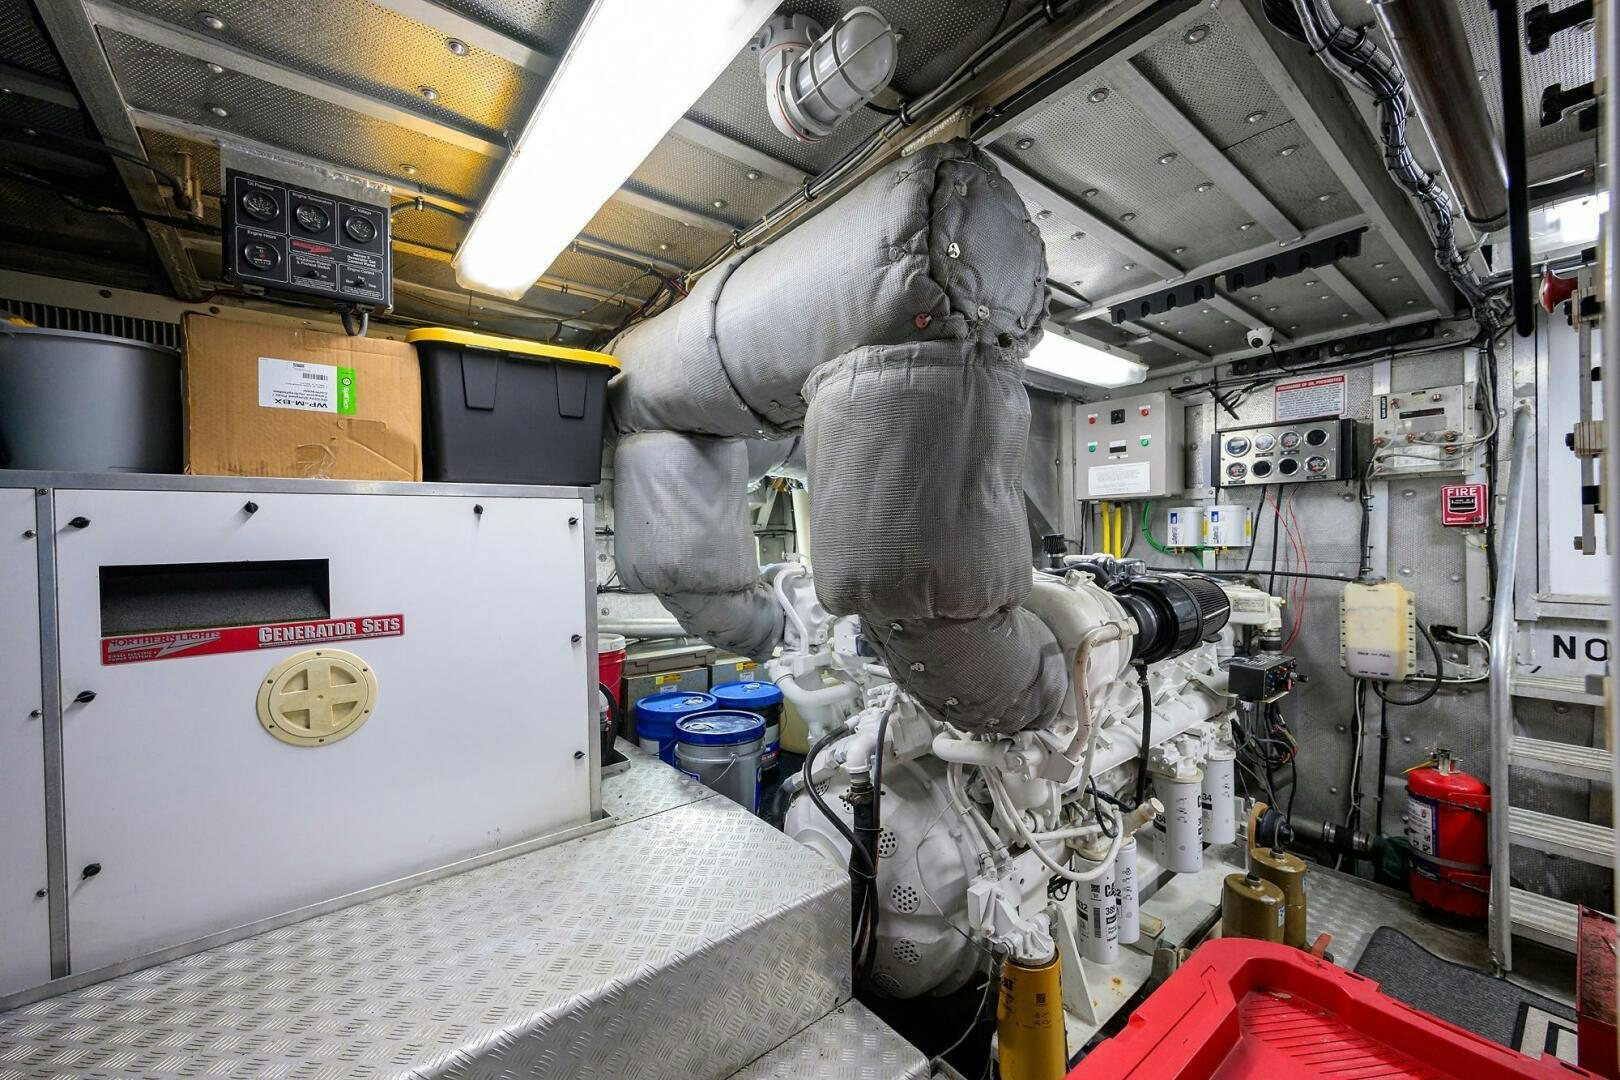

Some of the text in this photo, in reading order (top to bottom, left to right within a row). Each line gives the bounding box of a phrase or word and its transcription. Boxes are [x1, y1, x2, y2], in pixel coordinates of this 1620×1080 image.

[1447, 487, 1477, 497] FIRE
[258, 617, 401, 643] GENERATOR SETS
[109, 631, 221, 647] NORTHERN LIGHTS
